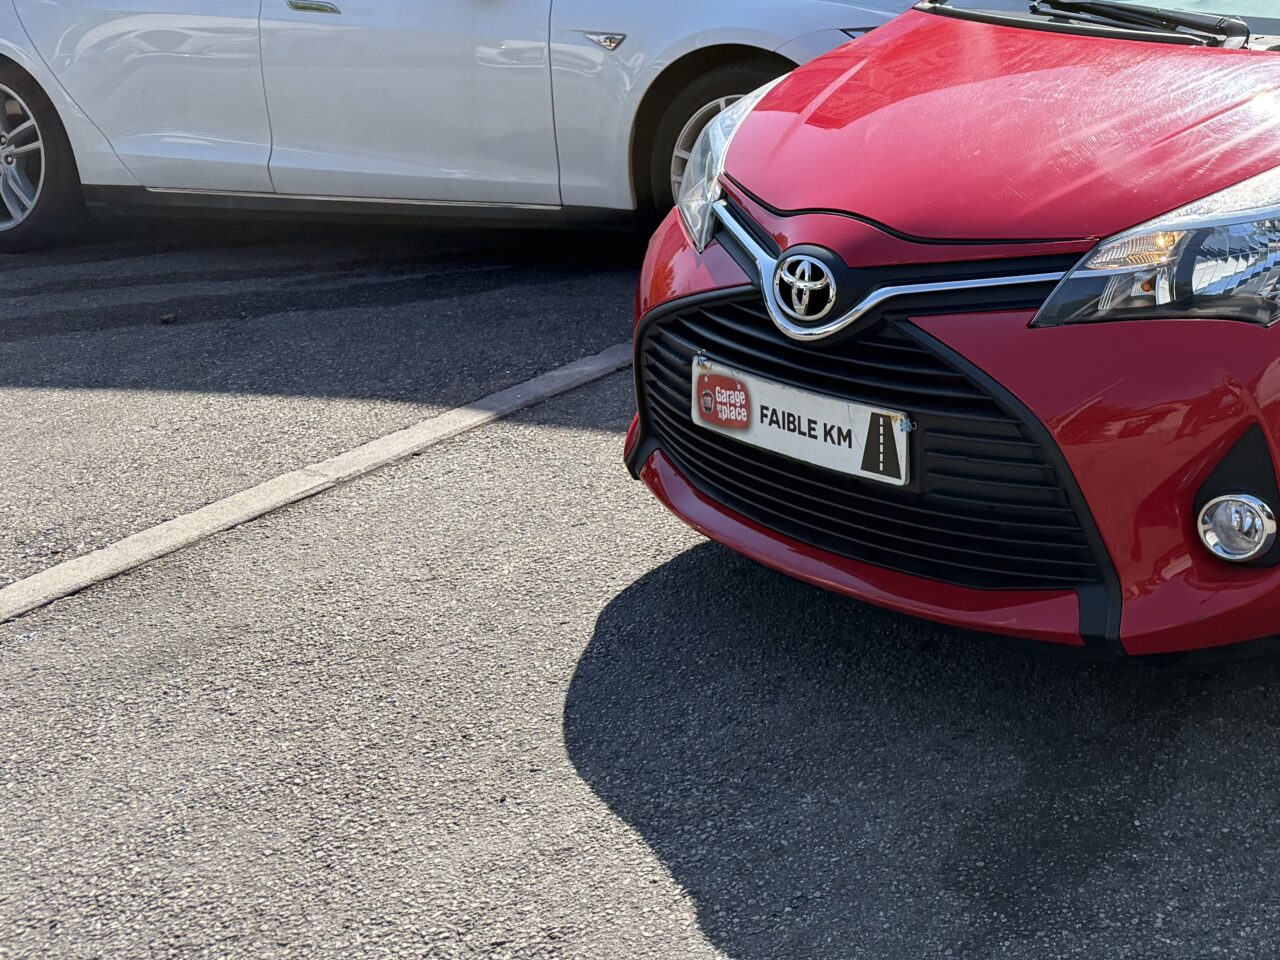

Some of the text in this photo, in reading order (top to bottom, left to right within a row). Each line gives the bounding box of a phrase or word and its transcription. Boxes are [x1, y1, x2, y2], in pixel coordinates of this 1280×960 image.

[715, 386, 746, 406] Garage
[722, 404, 747, 421] place
[759, 404, 818, 441] FAIBLE
[823, 422, 853, 449] KM
